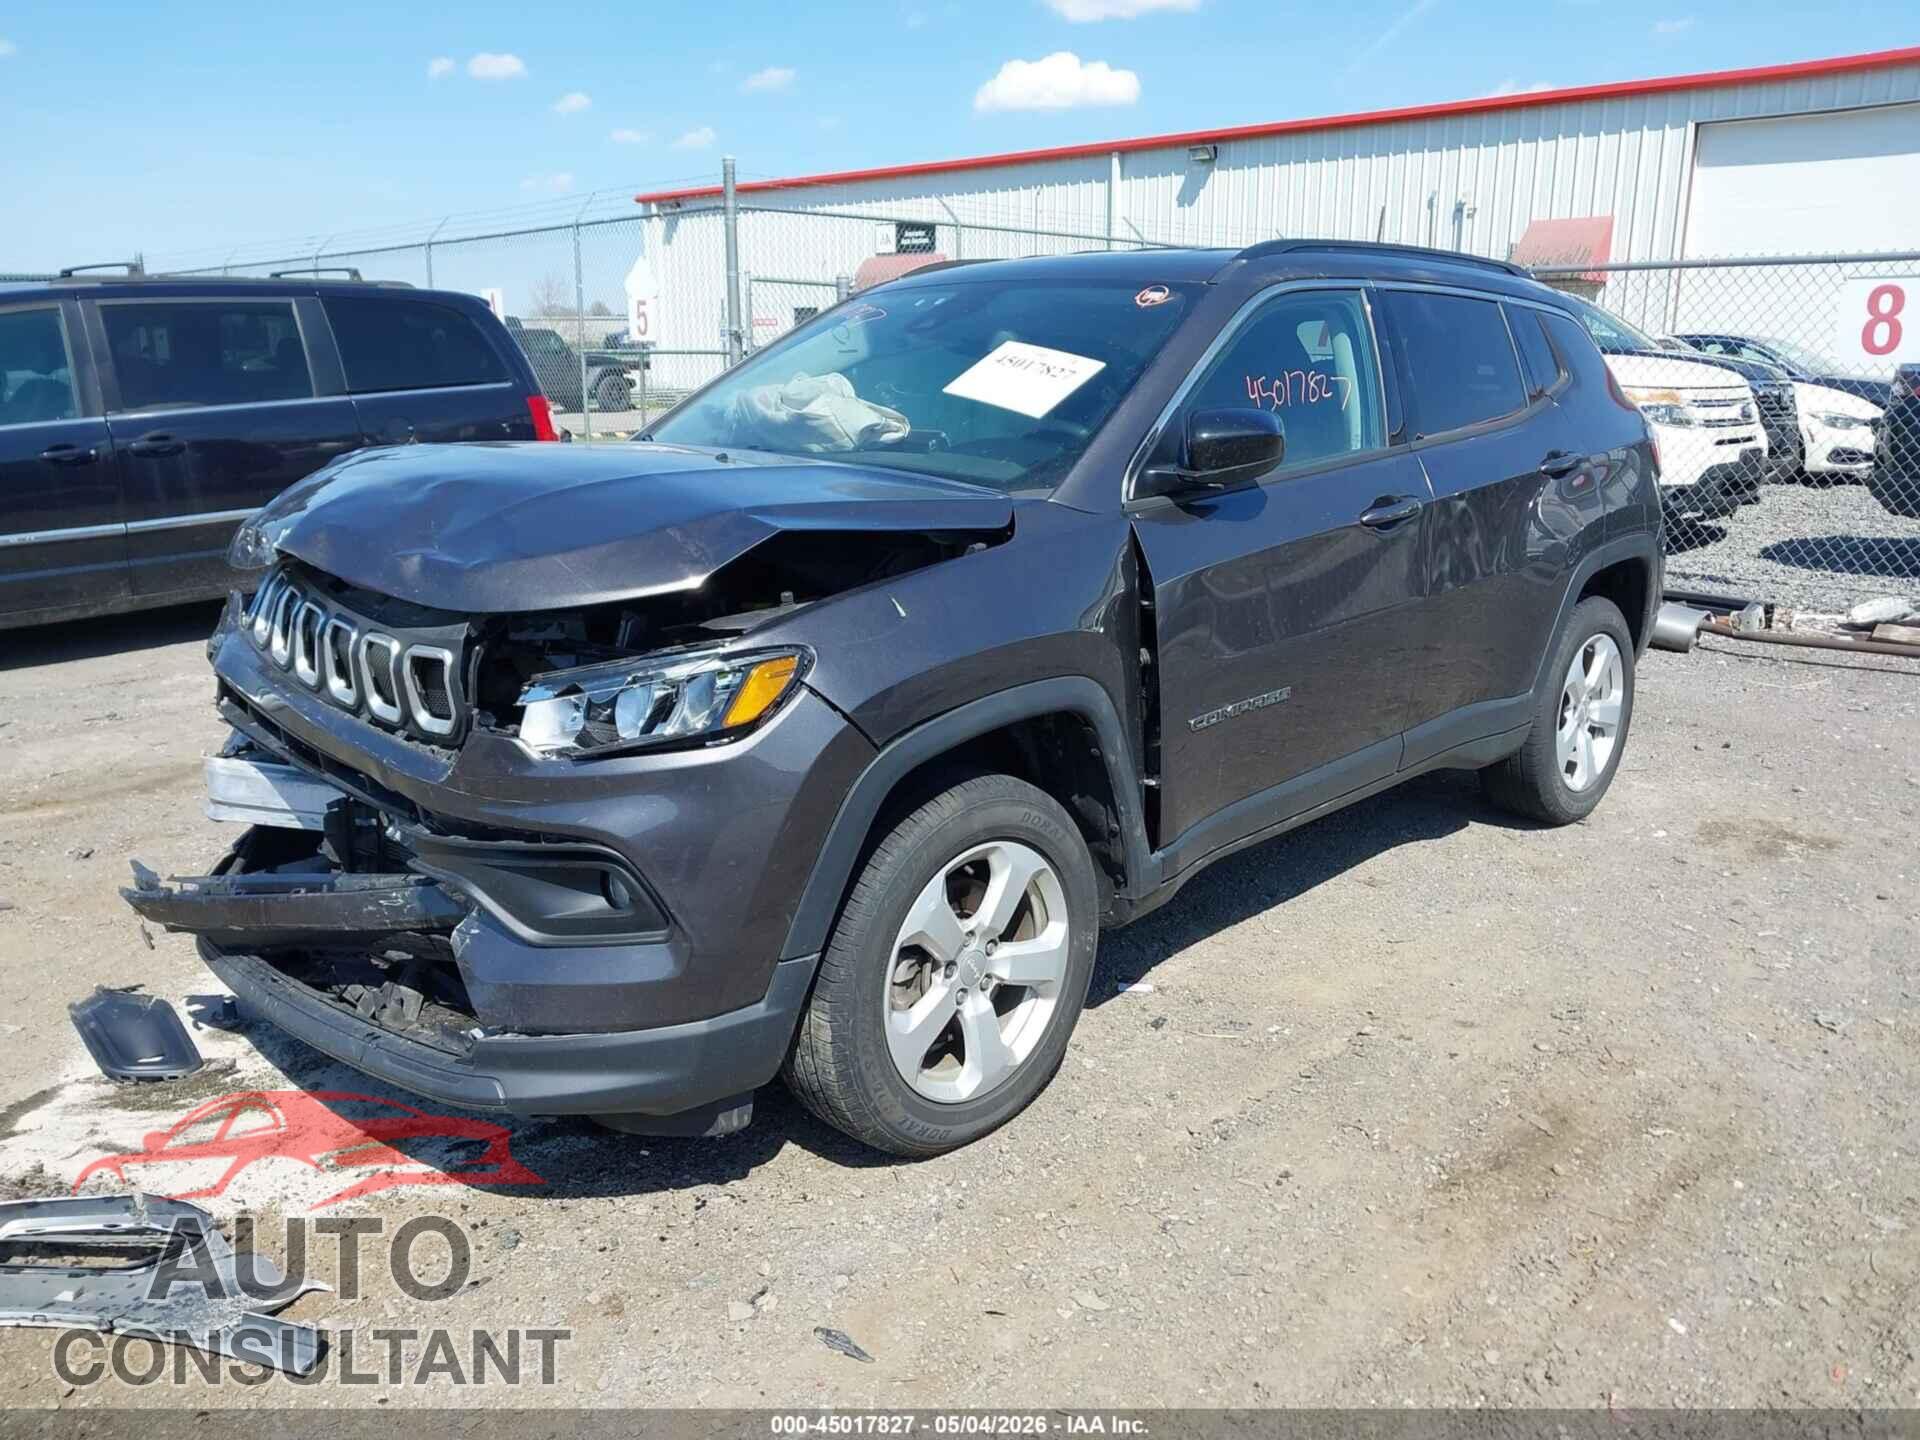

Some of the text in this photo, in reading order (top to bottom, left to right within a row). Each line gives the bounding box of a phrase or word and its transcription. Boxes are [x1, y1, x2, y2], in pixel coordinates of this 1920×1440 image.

[636, 299, 648, 336] 5
[1861, 284, 1905, 355] 8
[1245, 370, 1352, 412] 45017827
